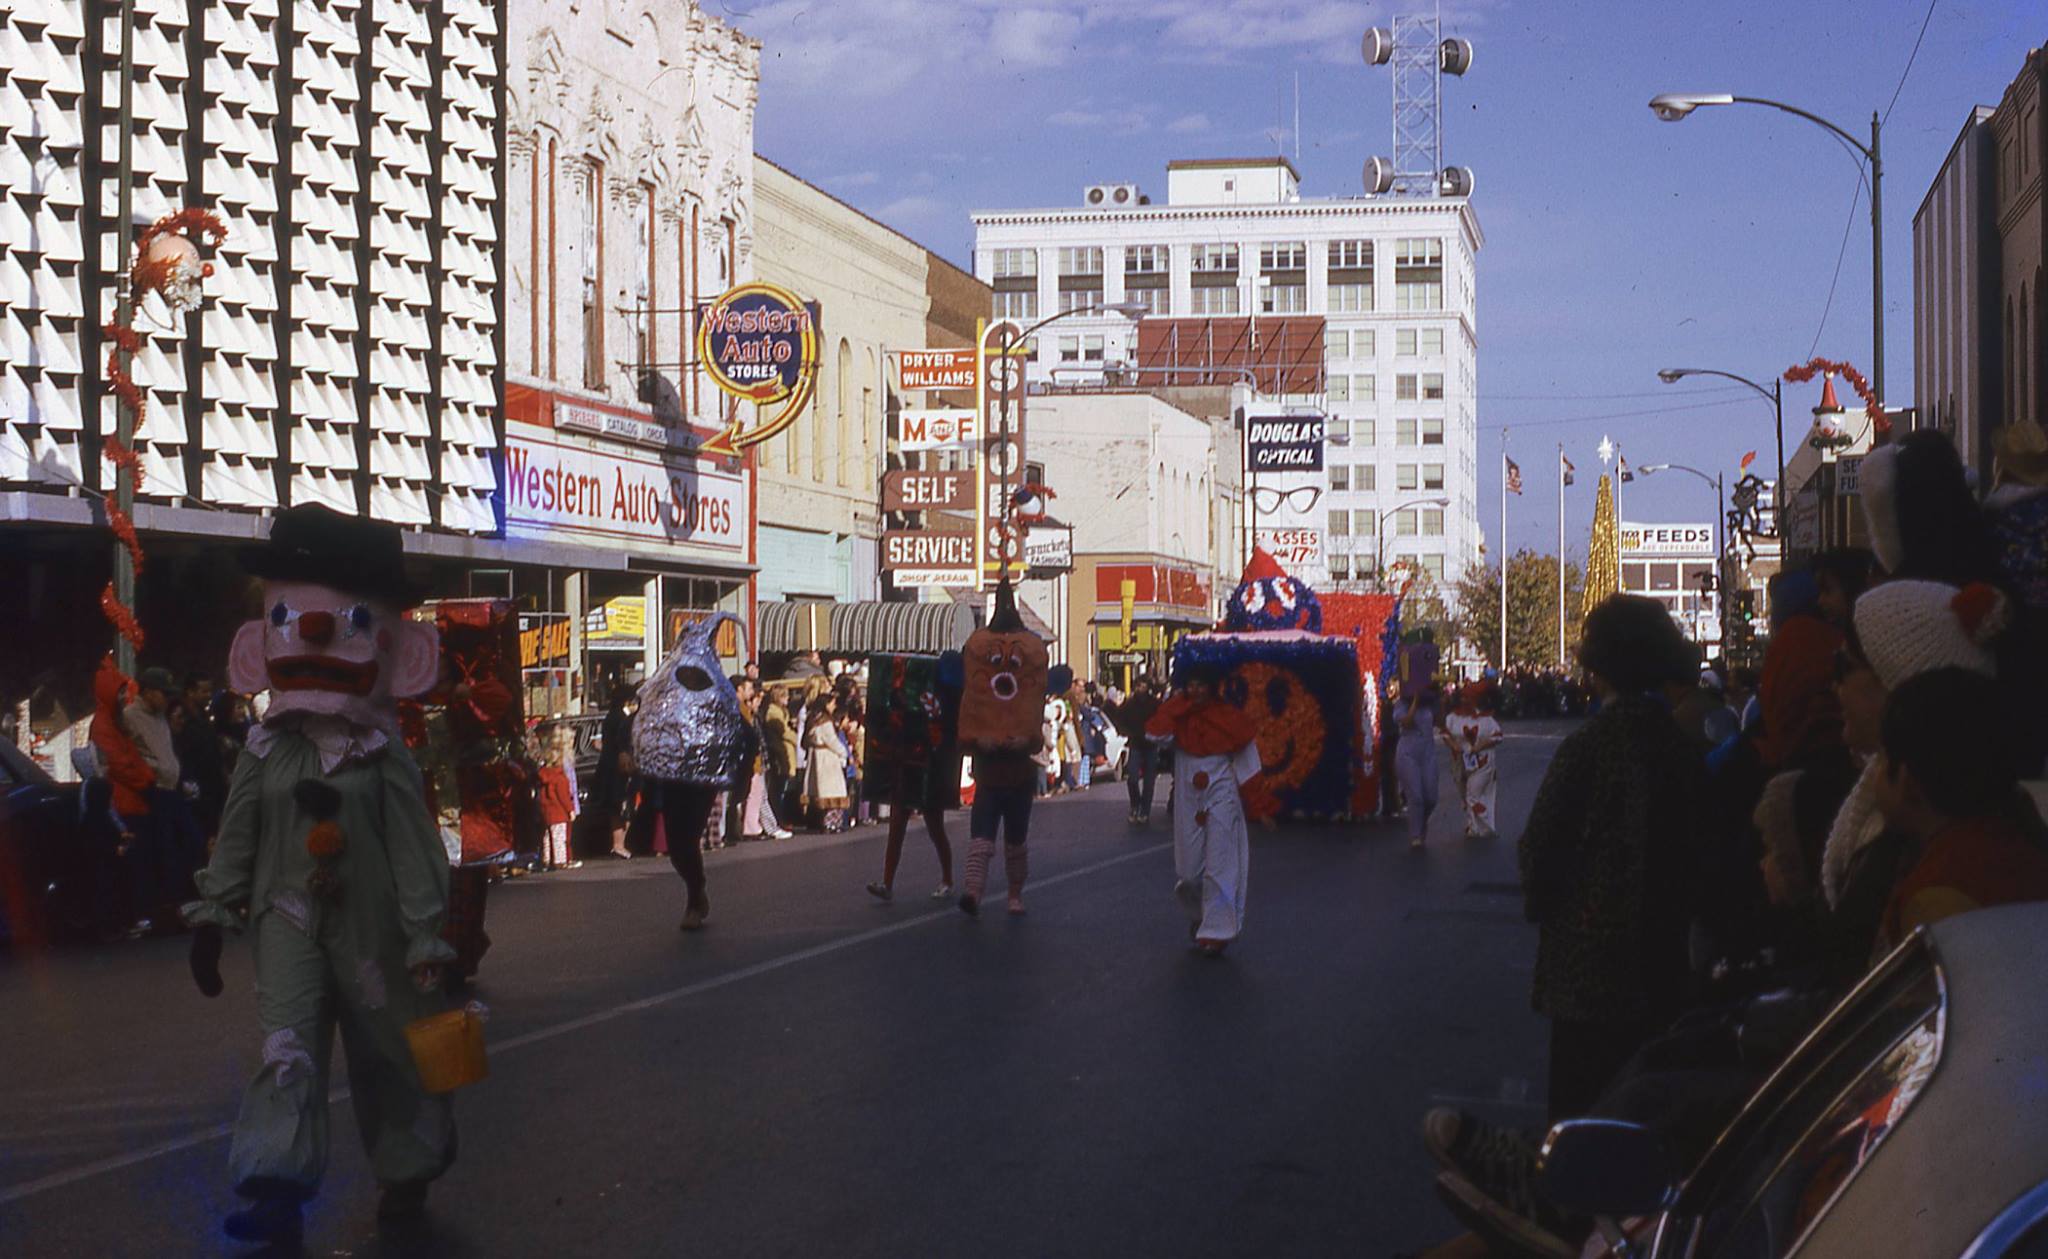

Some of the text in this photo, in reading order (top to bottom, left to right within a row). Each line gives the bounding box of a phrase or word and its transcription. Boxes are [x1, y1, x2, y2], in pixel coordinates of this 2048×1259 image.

[701, 305, 811, 334] Western
[720, 334, 793, 363] Auto
[727, 364, 778, 379] STORES
[903, 370, 975, 385] WILLIAMS
[606, 418, 638, 436] CATALOG
[903, 417, 926, 441] M
[957, 416, 974, 441] F
[1250, 422, 1322, 444] DOUGLAS
[989, 357, 1019, 560] SHOES
[1257, 448, 1314, 465] OPTICAL
[505, 446, 731, 536] Western Auto Stores
[902, 477, 957, 504] SELF
[1644, 529, 1709, 542] FEEDS
[1660, 543, 1710, 551] DEPENDABLE
[889, 537, 973, 564] SERVICE
[541, 619, 571, 661] SALE
